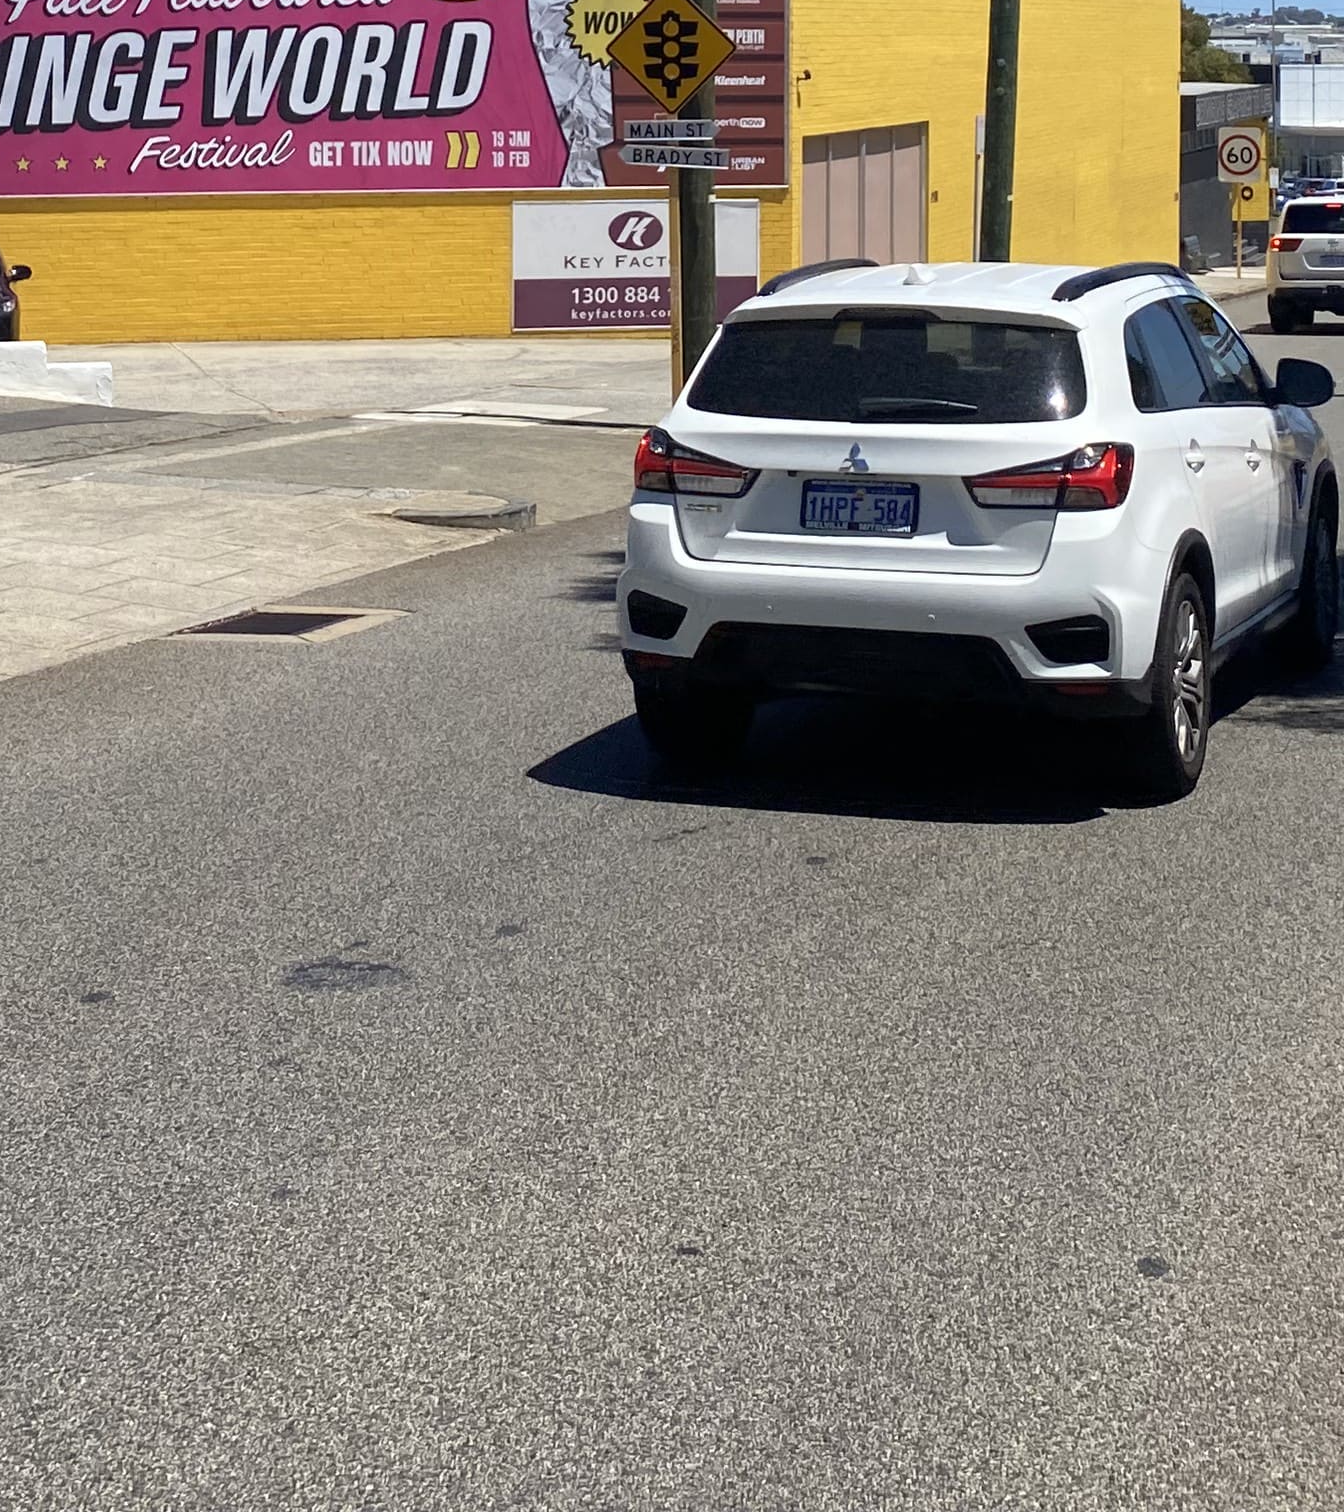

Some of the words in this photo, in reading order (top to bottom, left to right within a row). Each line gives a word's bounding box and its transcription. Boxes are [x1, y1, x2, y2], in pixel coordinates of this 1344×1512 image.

[210, 20, 493, 121] WORLD
[491, 130, 504, 147] 19
[508, 130, 530, 147] JAN
[629, 123, 675, 138] MAIN
[686, 123, 705, 137] ST
[129, 130, 296, 173] Festival
[309, 141, 346, 167] GET
[350, 141, 382, 167] TIX
[387, 140, 433, 166] NOW
[491, 151, 504, 167] 18
[508, 151, 530, 167] FEB
[632, 149, 693, 164] BRADY
[704, 153, 723, 167] ST
[1227, 146, 1253, 164] 60
[564, 255, 604, 269] KEY
[615, 255, 669, 268] FACT
[571, 287, 618, 304] 1300
[624, 286, 661, 303] 884
[874, 498, 911, 525] 584
